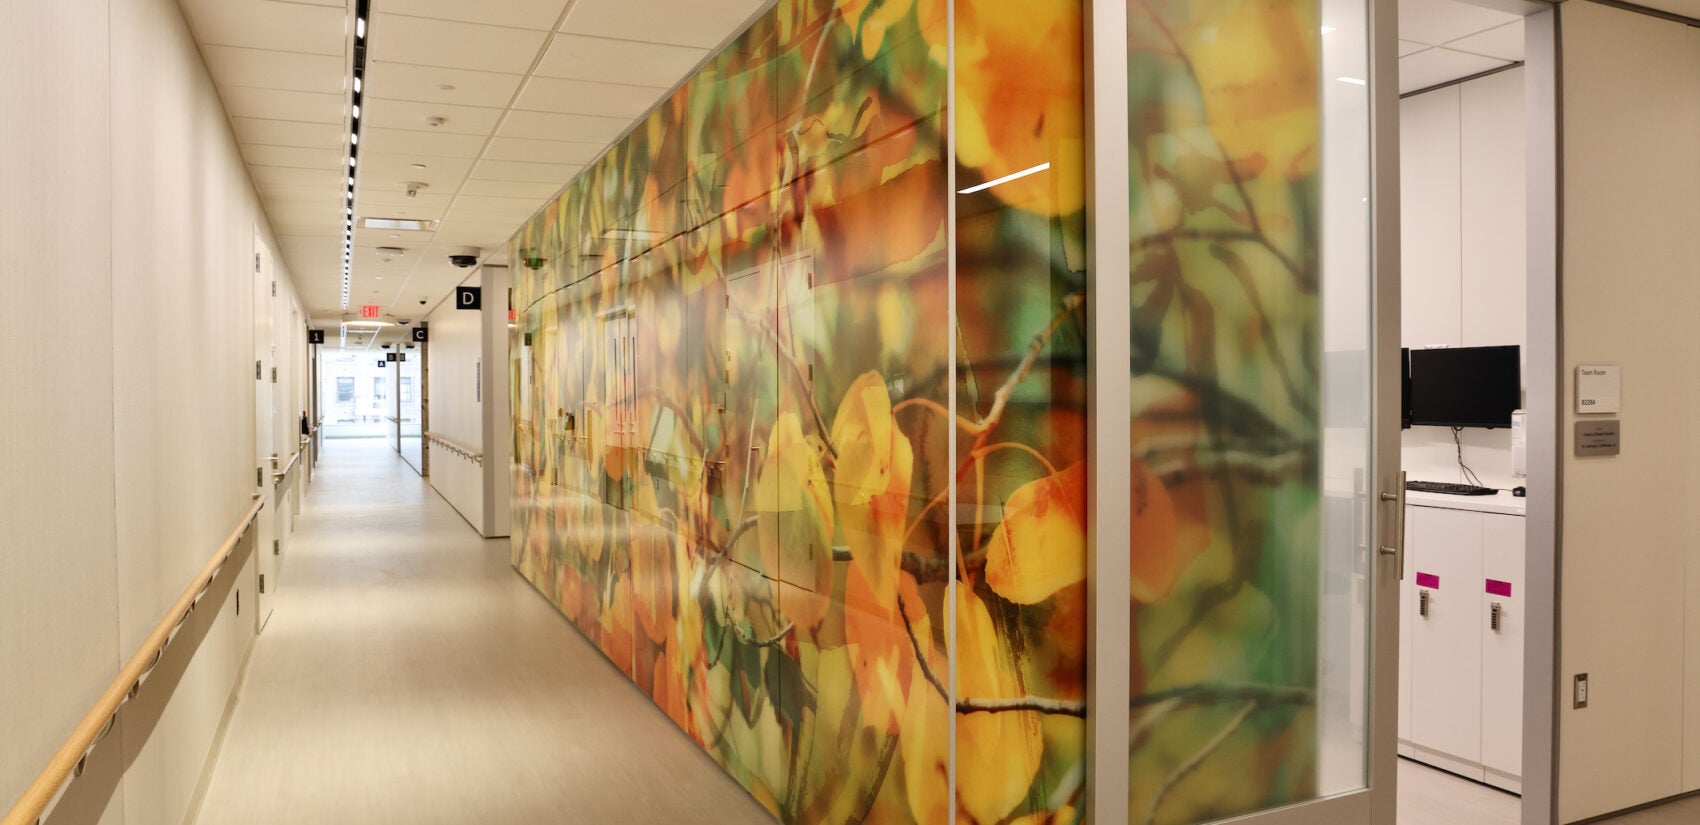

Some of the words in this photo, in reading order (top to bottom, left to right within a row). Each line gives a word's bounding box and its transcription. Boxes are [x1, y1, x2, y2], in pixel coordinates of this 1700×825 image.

[462, 291, 474, 305] D
[362, 305, 379, 319] EXIT
[313, 332, 320, 341] 1
[416, 330, 424, 339] C
